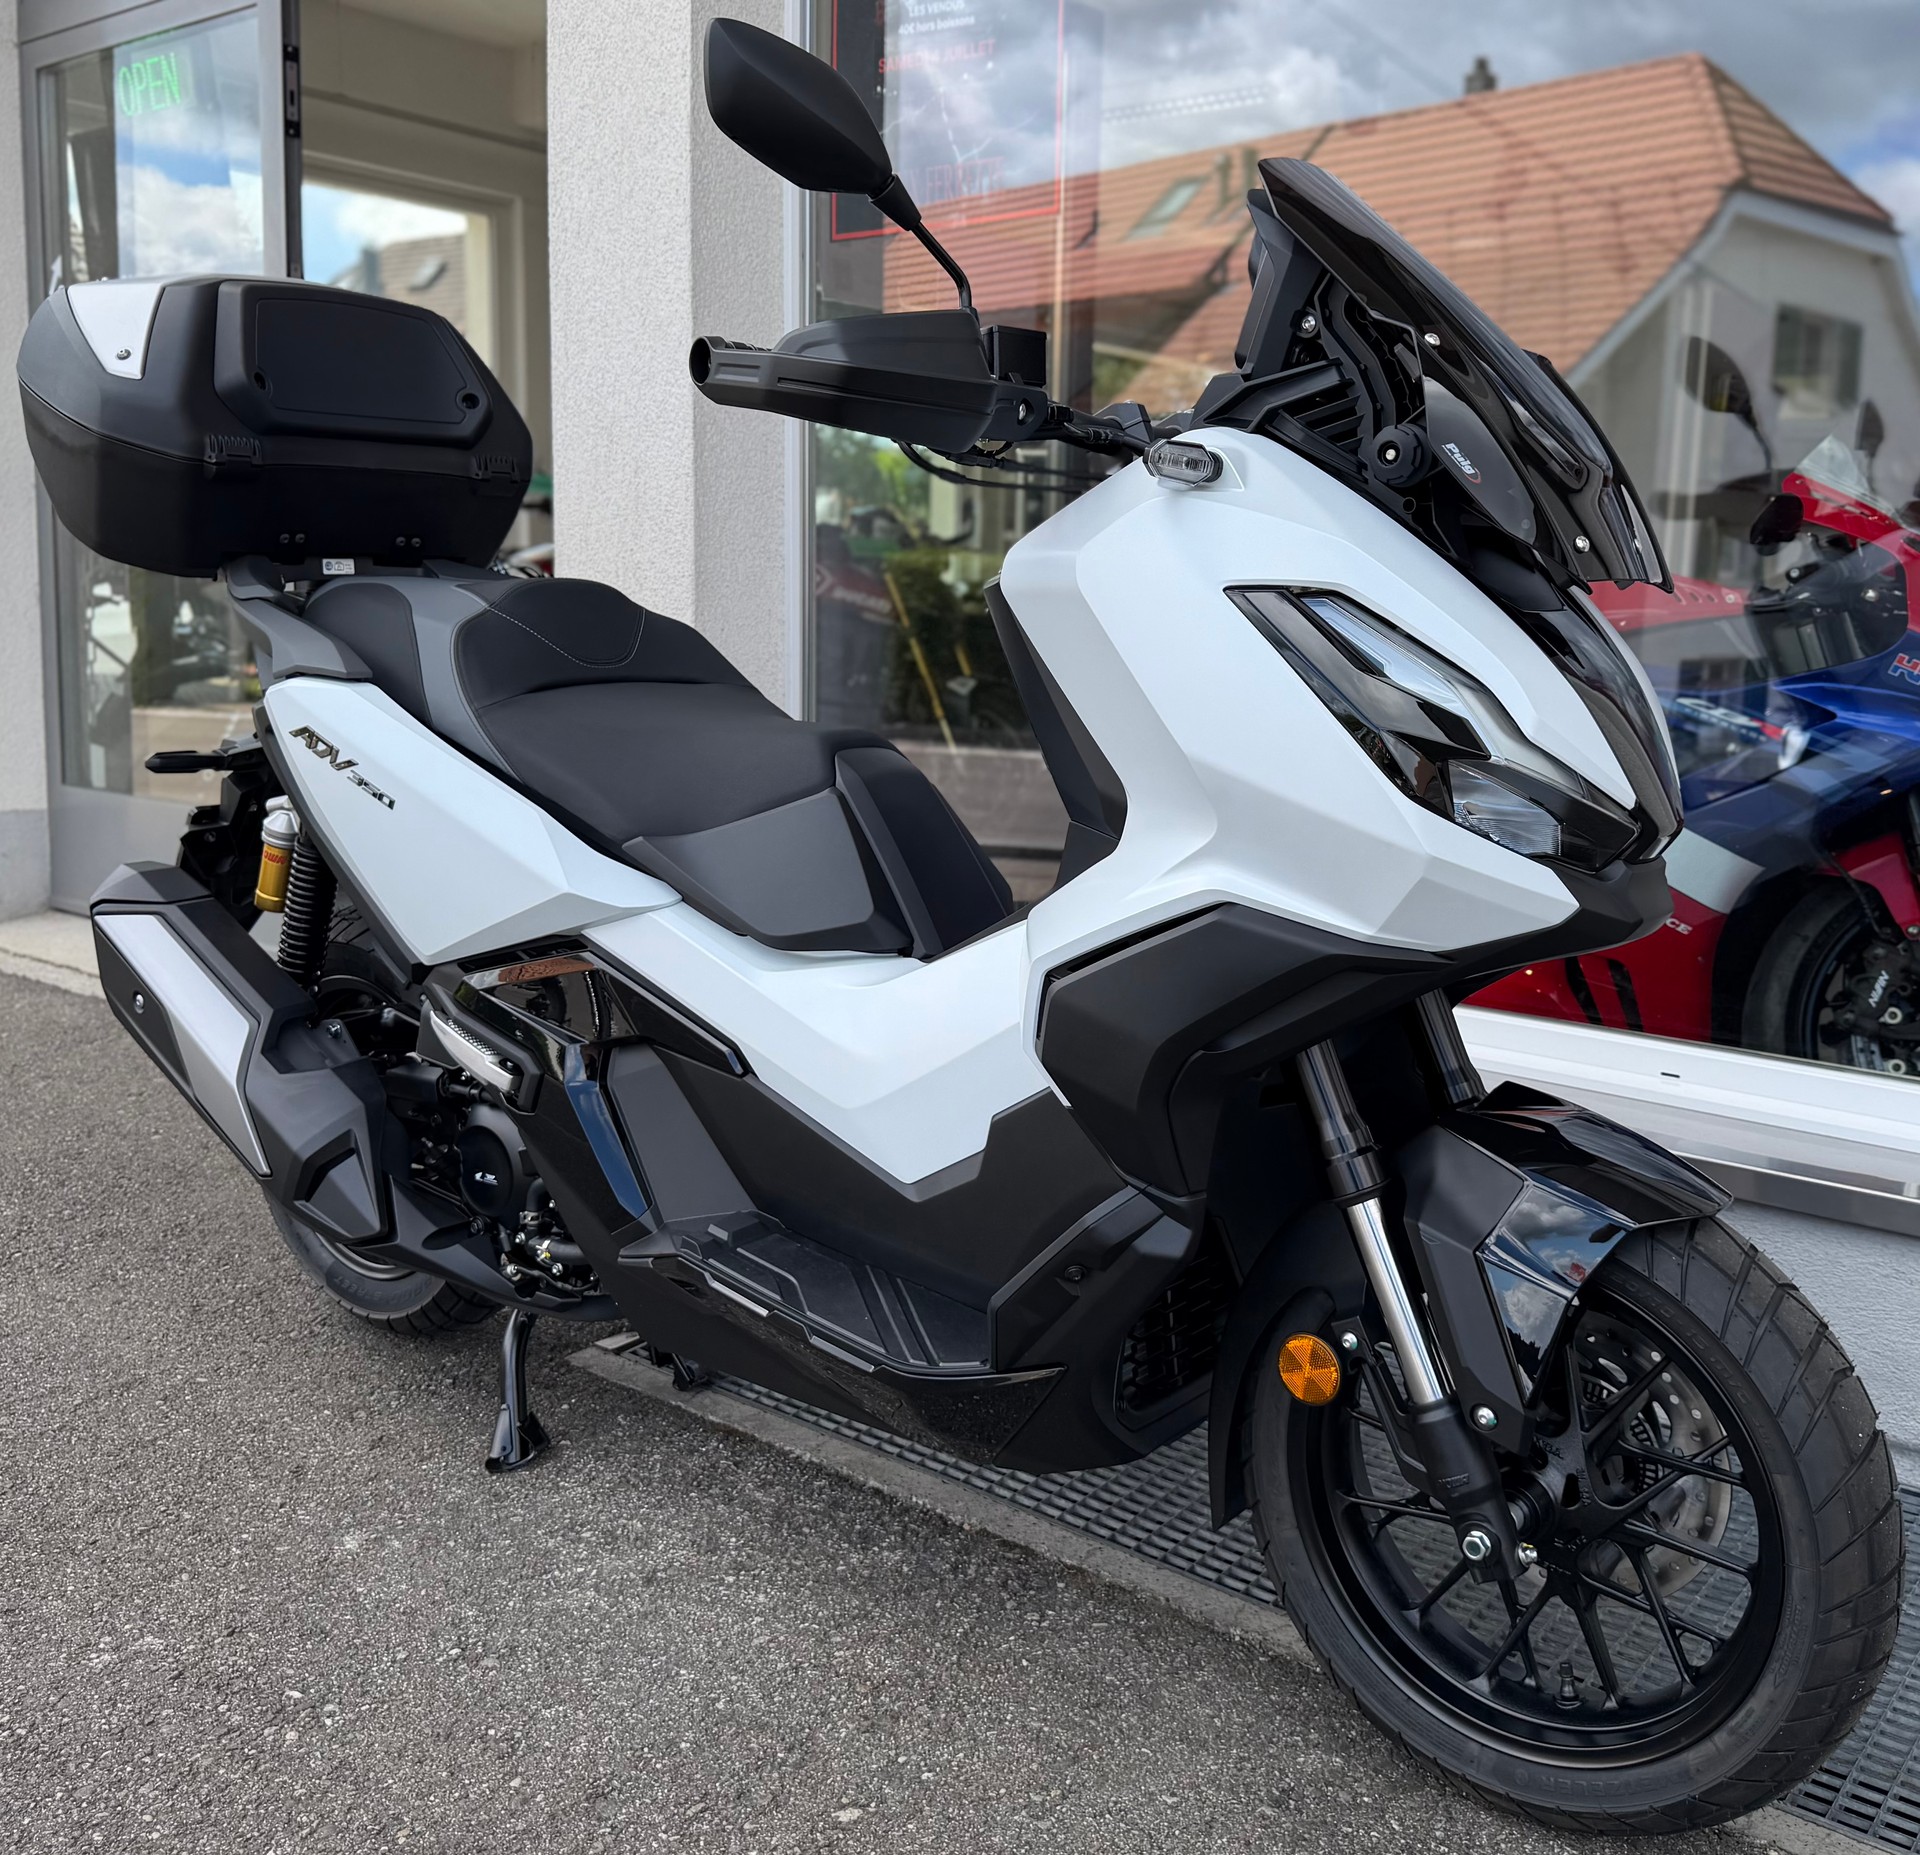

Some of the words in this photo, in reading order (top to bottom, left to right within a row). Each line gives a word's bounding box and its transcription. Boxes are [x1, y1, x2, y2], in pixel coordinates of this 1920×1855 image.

[916, 19, 936, 32] hors
[943, 38, 997, 63] JUILLET
[119, 52, 180, 117] OPEN
[289, 724, 359, 771] ADV
[346, 769, 396, 811] 350
